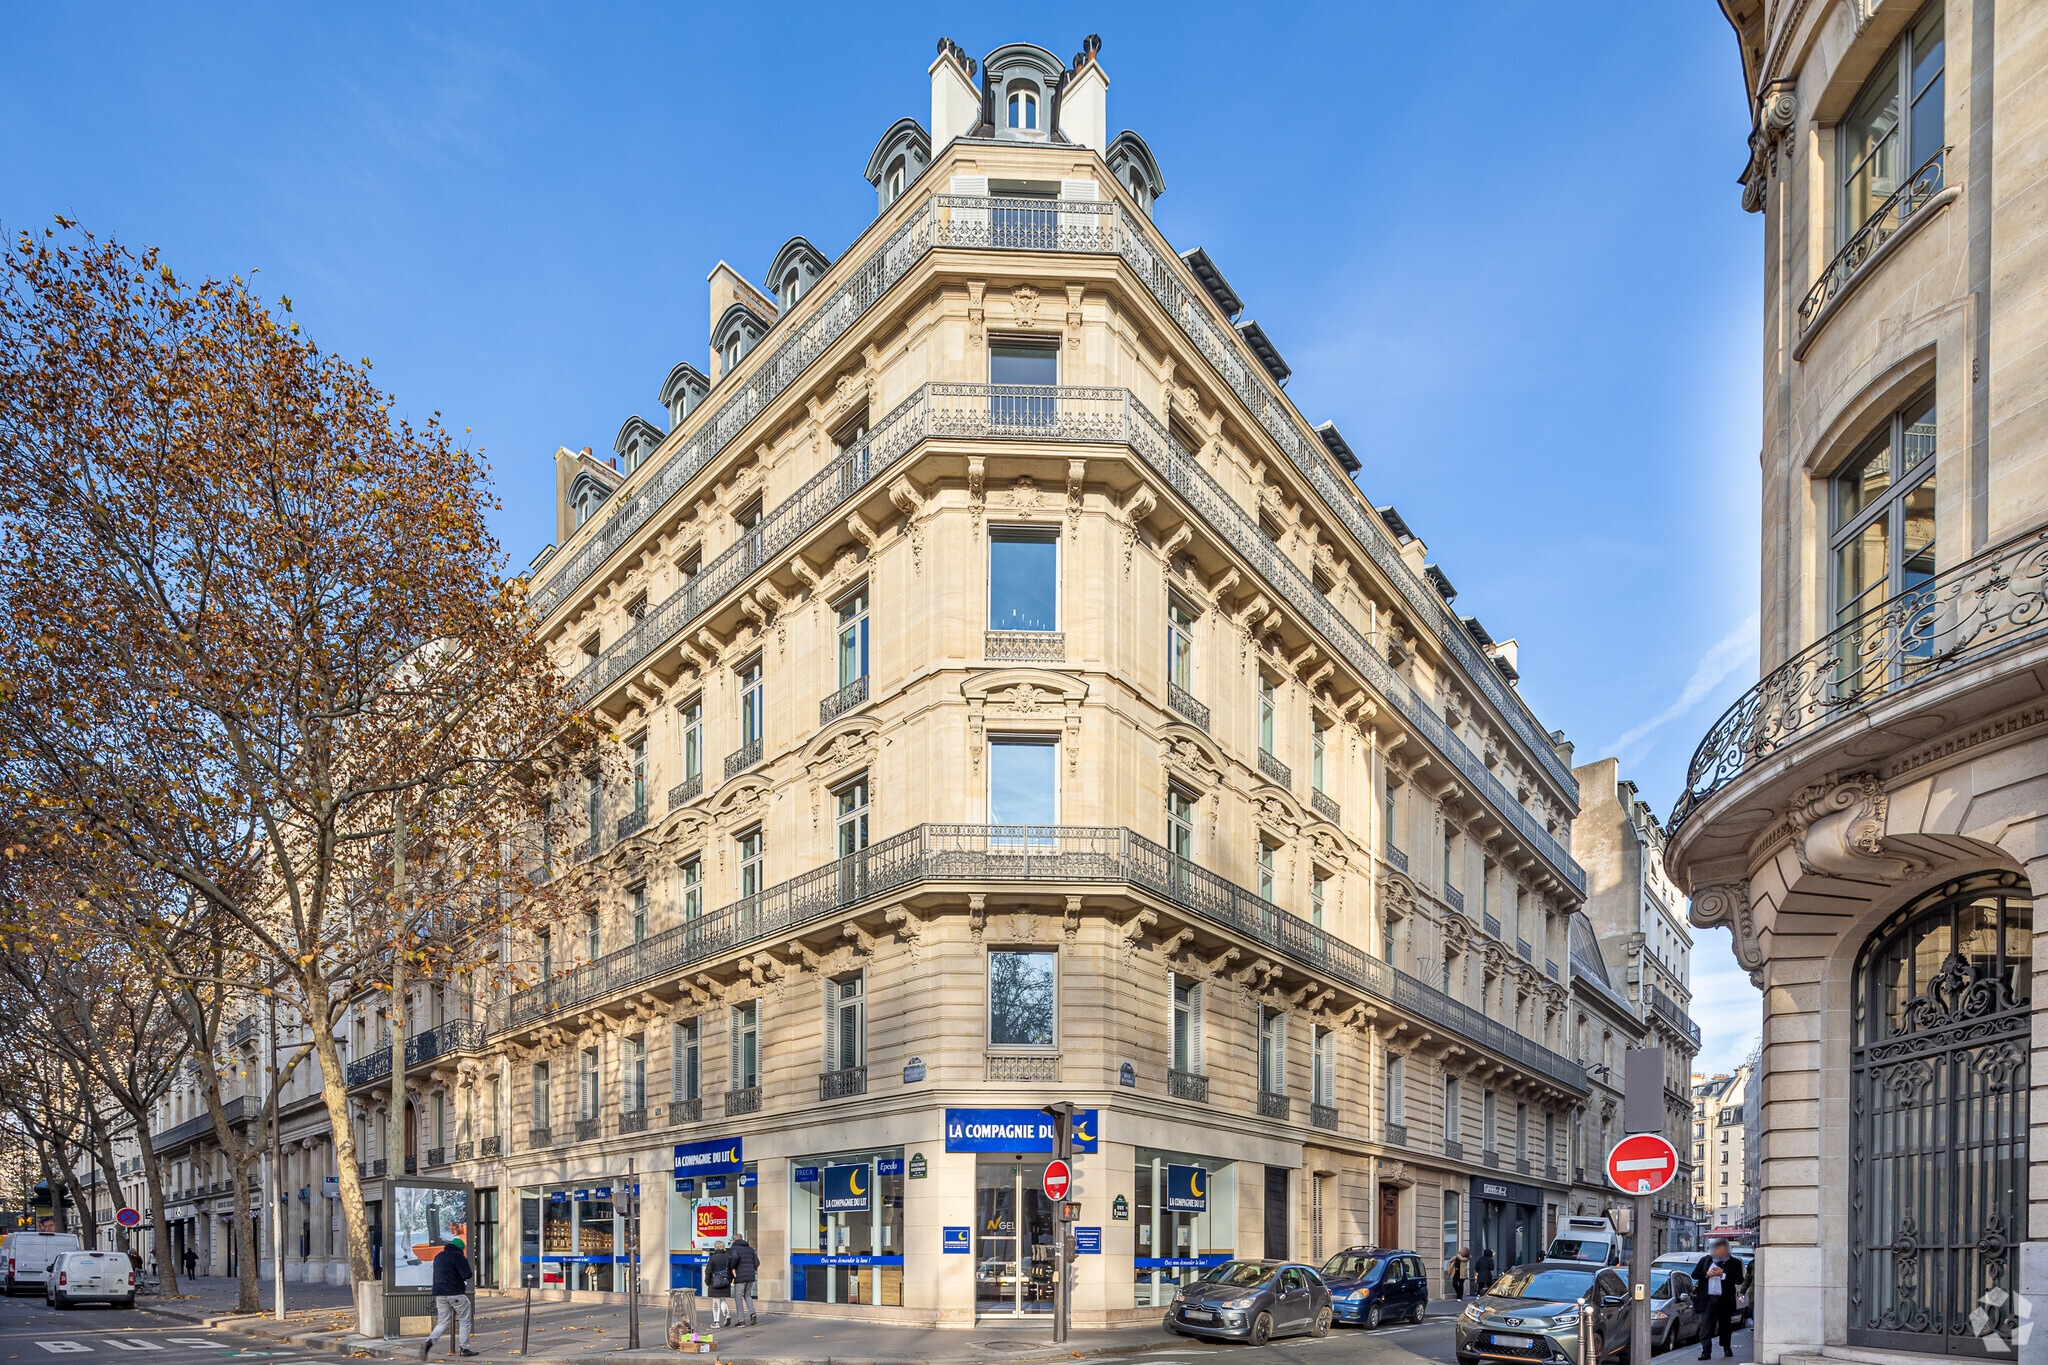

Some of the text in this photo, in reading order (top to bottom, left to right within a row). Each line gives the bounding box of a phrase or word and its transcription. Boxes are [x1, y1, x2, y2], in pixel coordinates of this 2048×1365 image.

[949, 1124, 1054, 1139] LA COMPAGNIE DU
[675, 1150, 731, 1168] LA COMPAGNIE DU LIT
[880, 1161, 898, 1172] Epeda
[825, 1199, 832, 1208] LA
[831, 1198, 854, 1208] COMPAGNIE
[1174, 1197, 1194, 1208] COMPAGNIE
[34, 1338, 231, 1354] BUS
